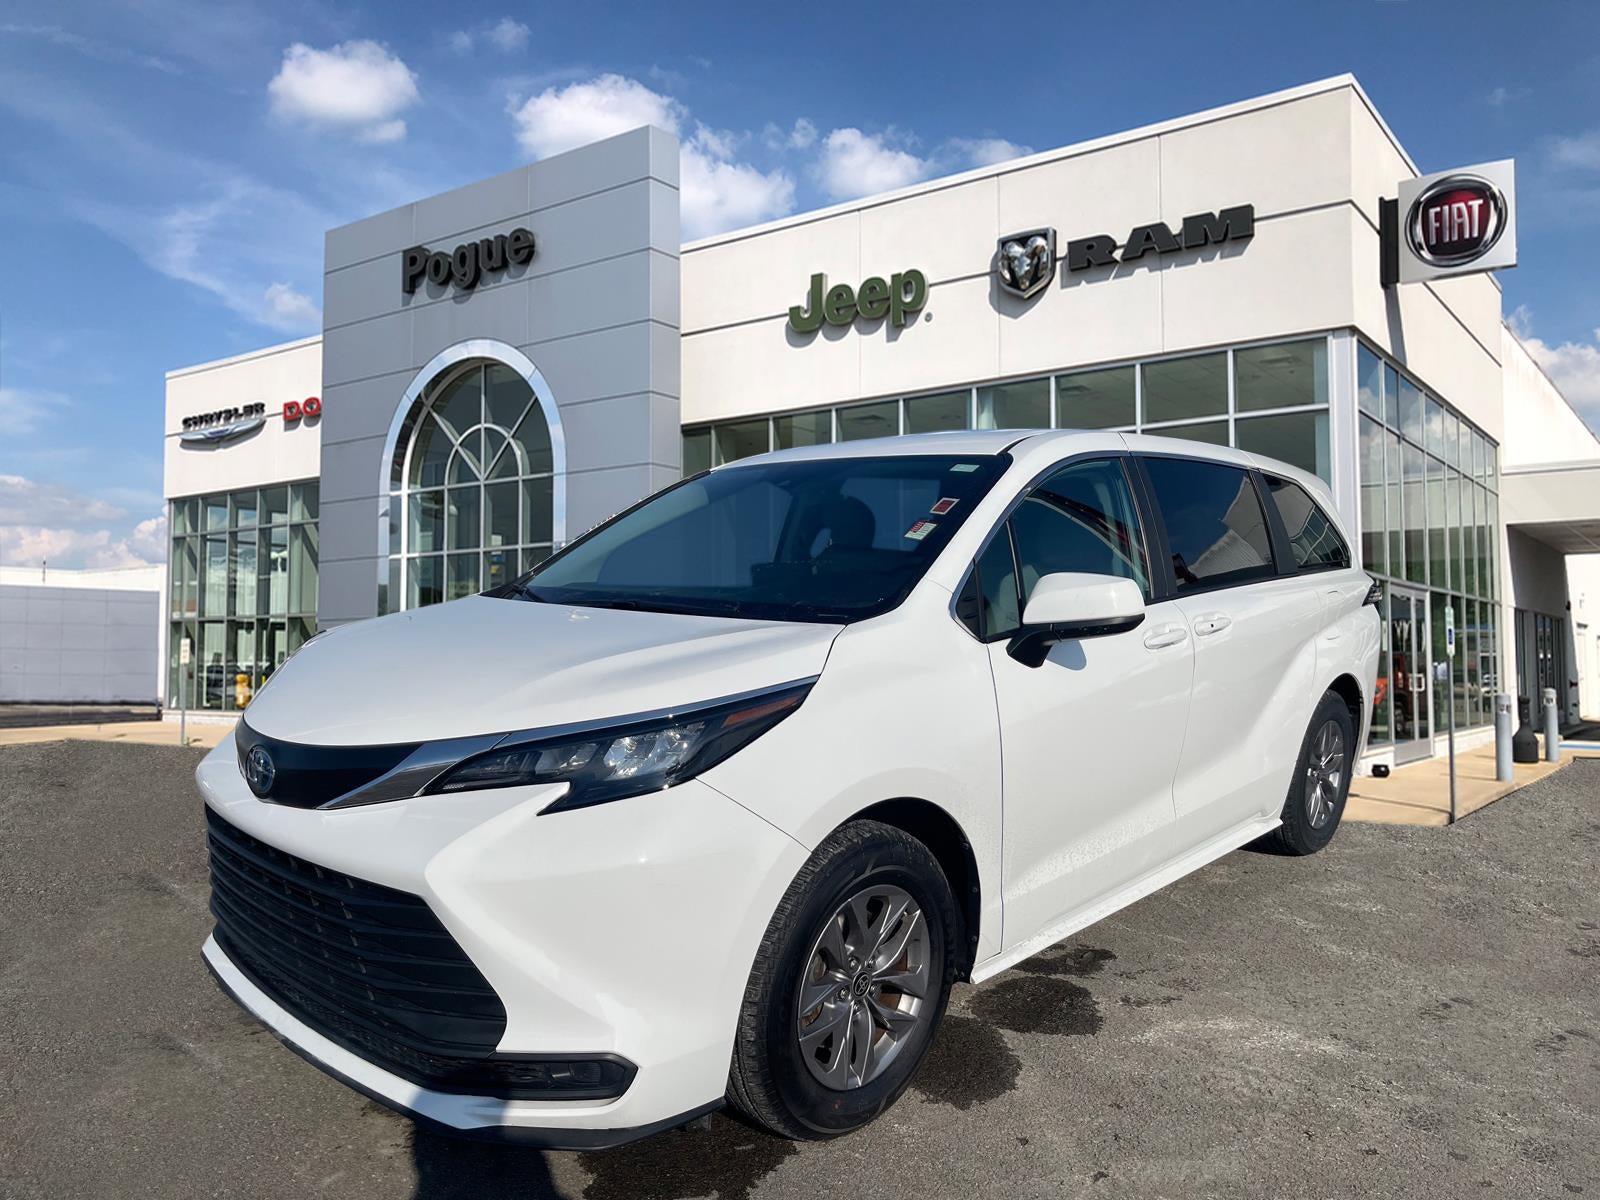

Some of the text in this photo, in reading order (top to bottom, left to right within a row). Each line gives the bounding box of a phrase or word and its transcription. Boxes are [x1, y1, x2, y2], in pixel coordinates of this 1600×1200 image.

[1067, 204, 1255, 272] RAM
[1428, 199, 1483, 246] FIAT
[402, 228, 535, 294] Pogue
[182, 402, 265, 428] CHRYSLER
